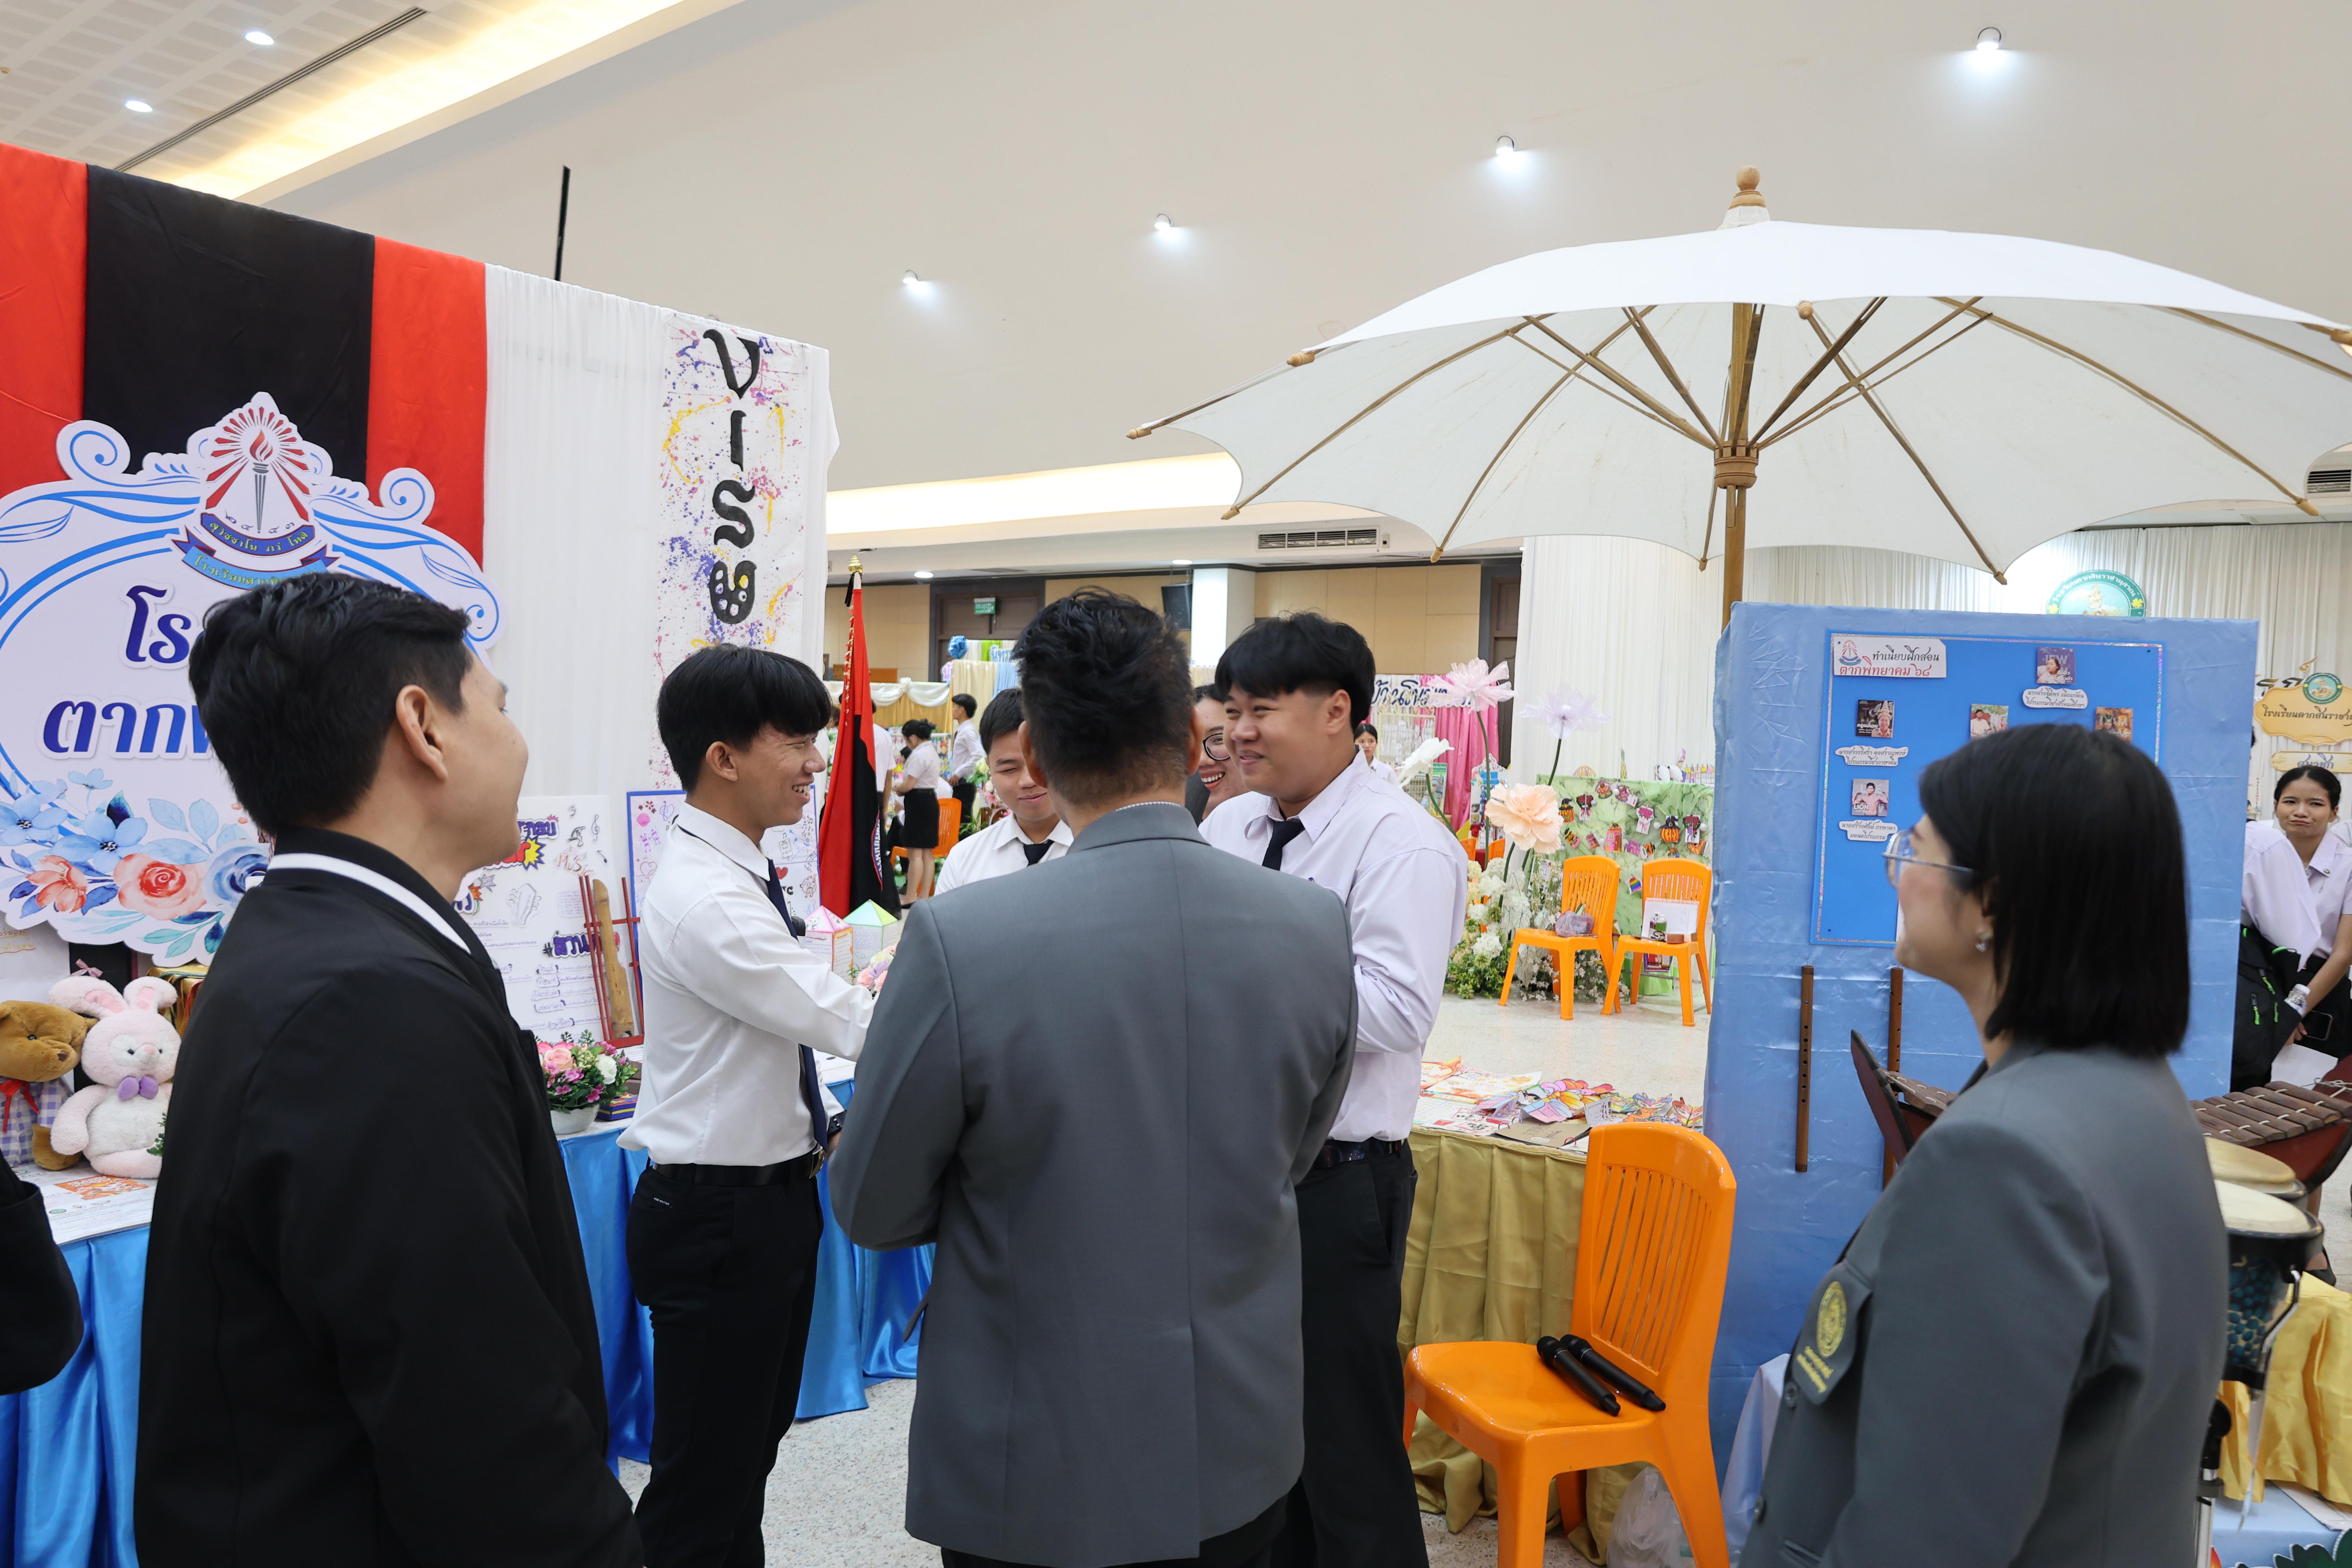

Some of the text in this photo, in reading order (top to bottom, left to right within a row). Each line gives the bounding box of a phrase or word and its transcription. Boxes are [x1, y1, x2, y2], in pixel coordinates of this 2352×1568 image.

[1873, 645, 1939, 661] ทำเนียบฝึกสอน
[1840, 655, 1911, 676] ตากพิทยาคม
